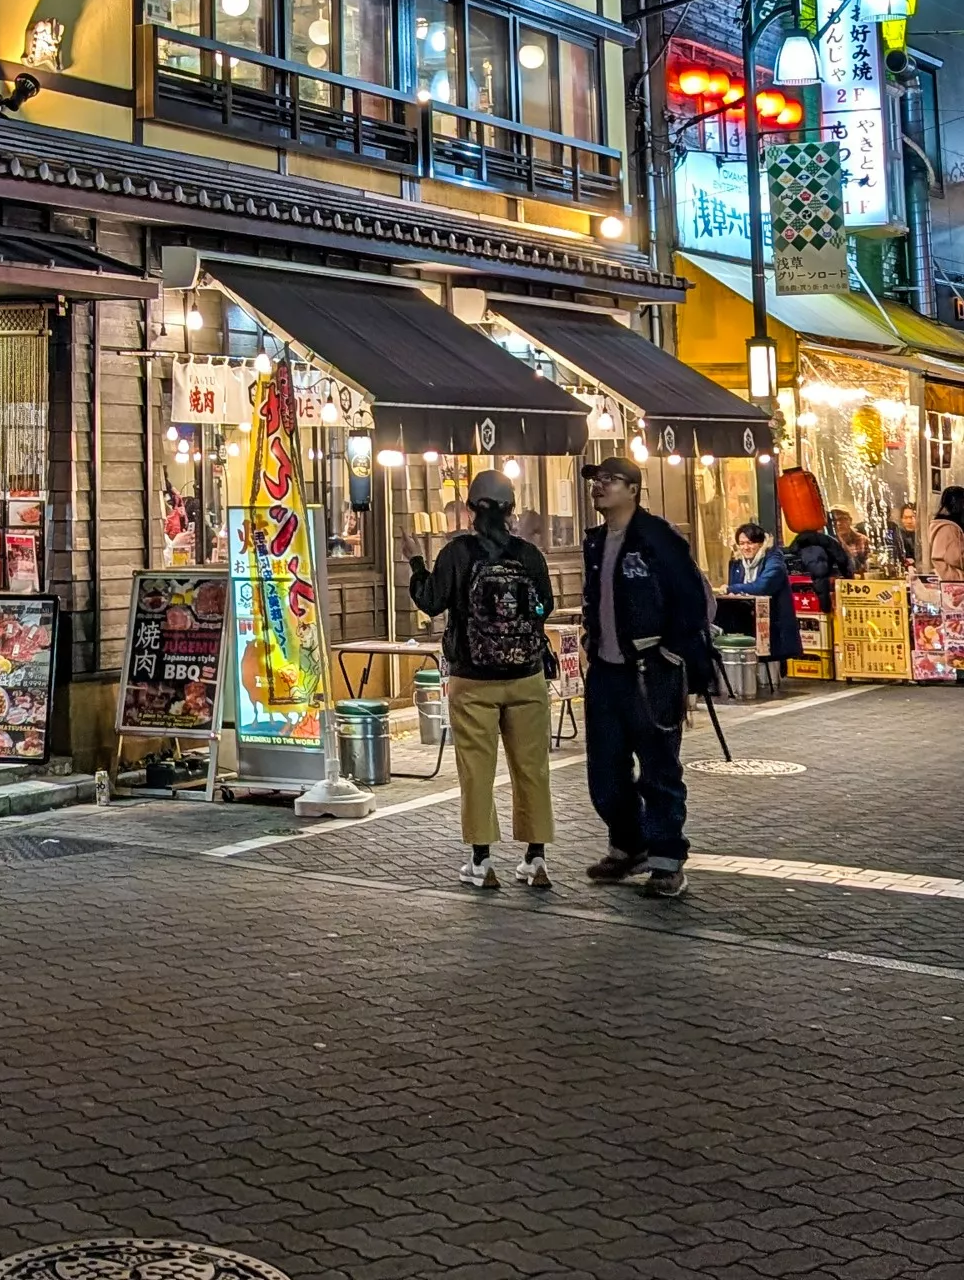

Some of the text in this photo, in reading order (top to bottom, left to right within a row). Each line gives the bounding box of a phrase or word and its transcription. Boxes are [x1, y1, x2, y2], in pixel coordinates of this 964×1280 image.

[856, 119, 878, 188] やきとん
[777, 256, 804, 271] 浅草
[778, 269, 847, 281] グリーンロード
[189, 385, 216, 415] 焼肉
[133, 621, 161, 680] 焼肉
[163, 653, 216, 663] Japanese style
[164, 664, 200, 682] BBQ
[295, 738, 321, 746] WORLD
